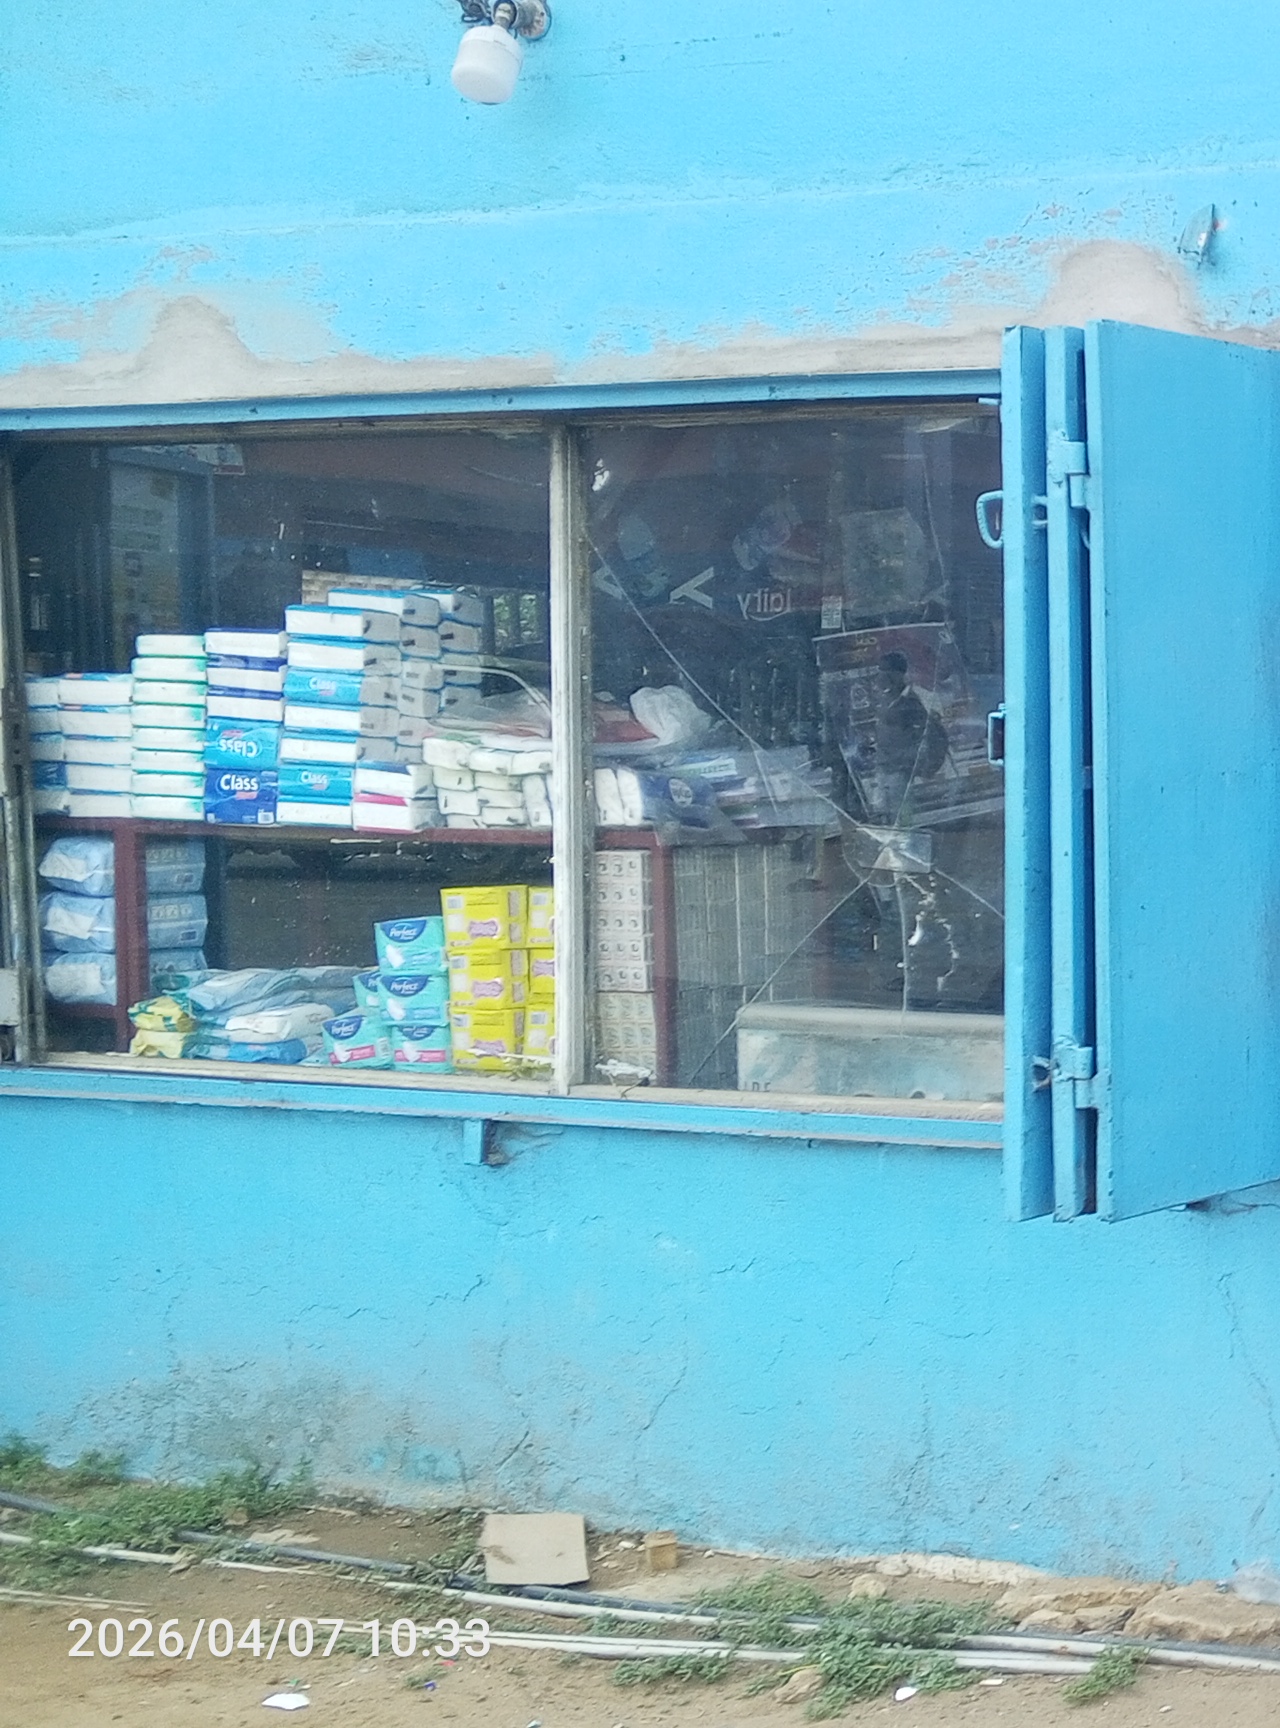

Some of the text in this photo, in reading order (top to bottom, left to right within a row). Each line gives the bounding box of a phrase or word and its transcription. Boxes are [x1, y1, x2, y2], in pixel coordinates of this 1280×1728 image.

[219, 738, 258, 758] Class
[220, 774, 258, 790] Class
[301, 771, 328, 784] Class
[389, 926, 417, 938] Perfect
[391, 981, 419, 992] Perfect
